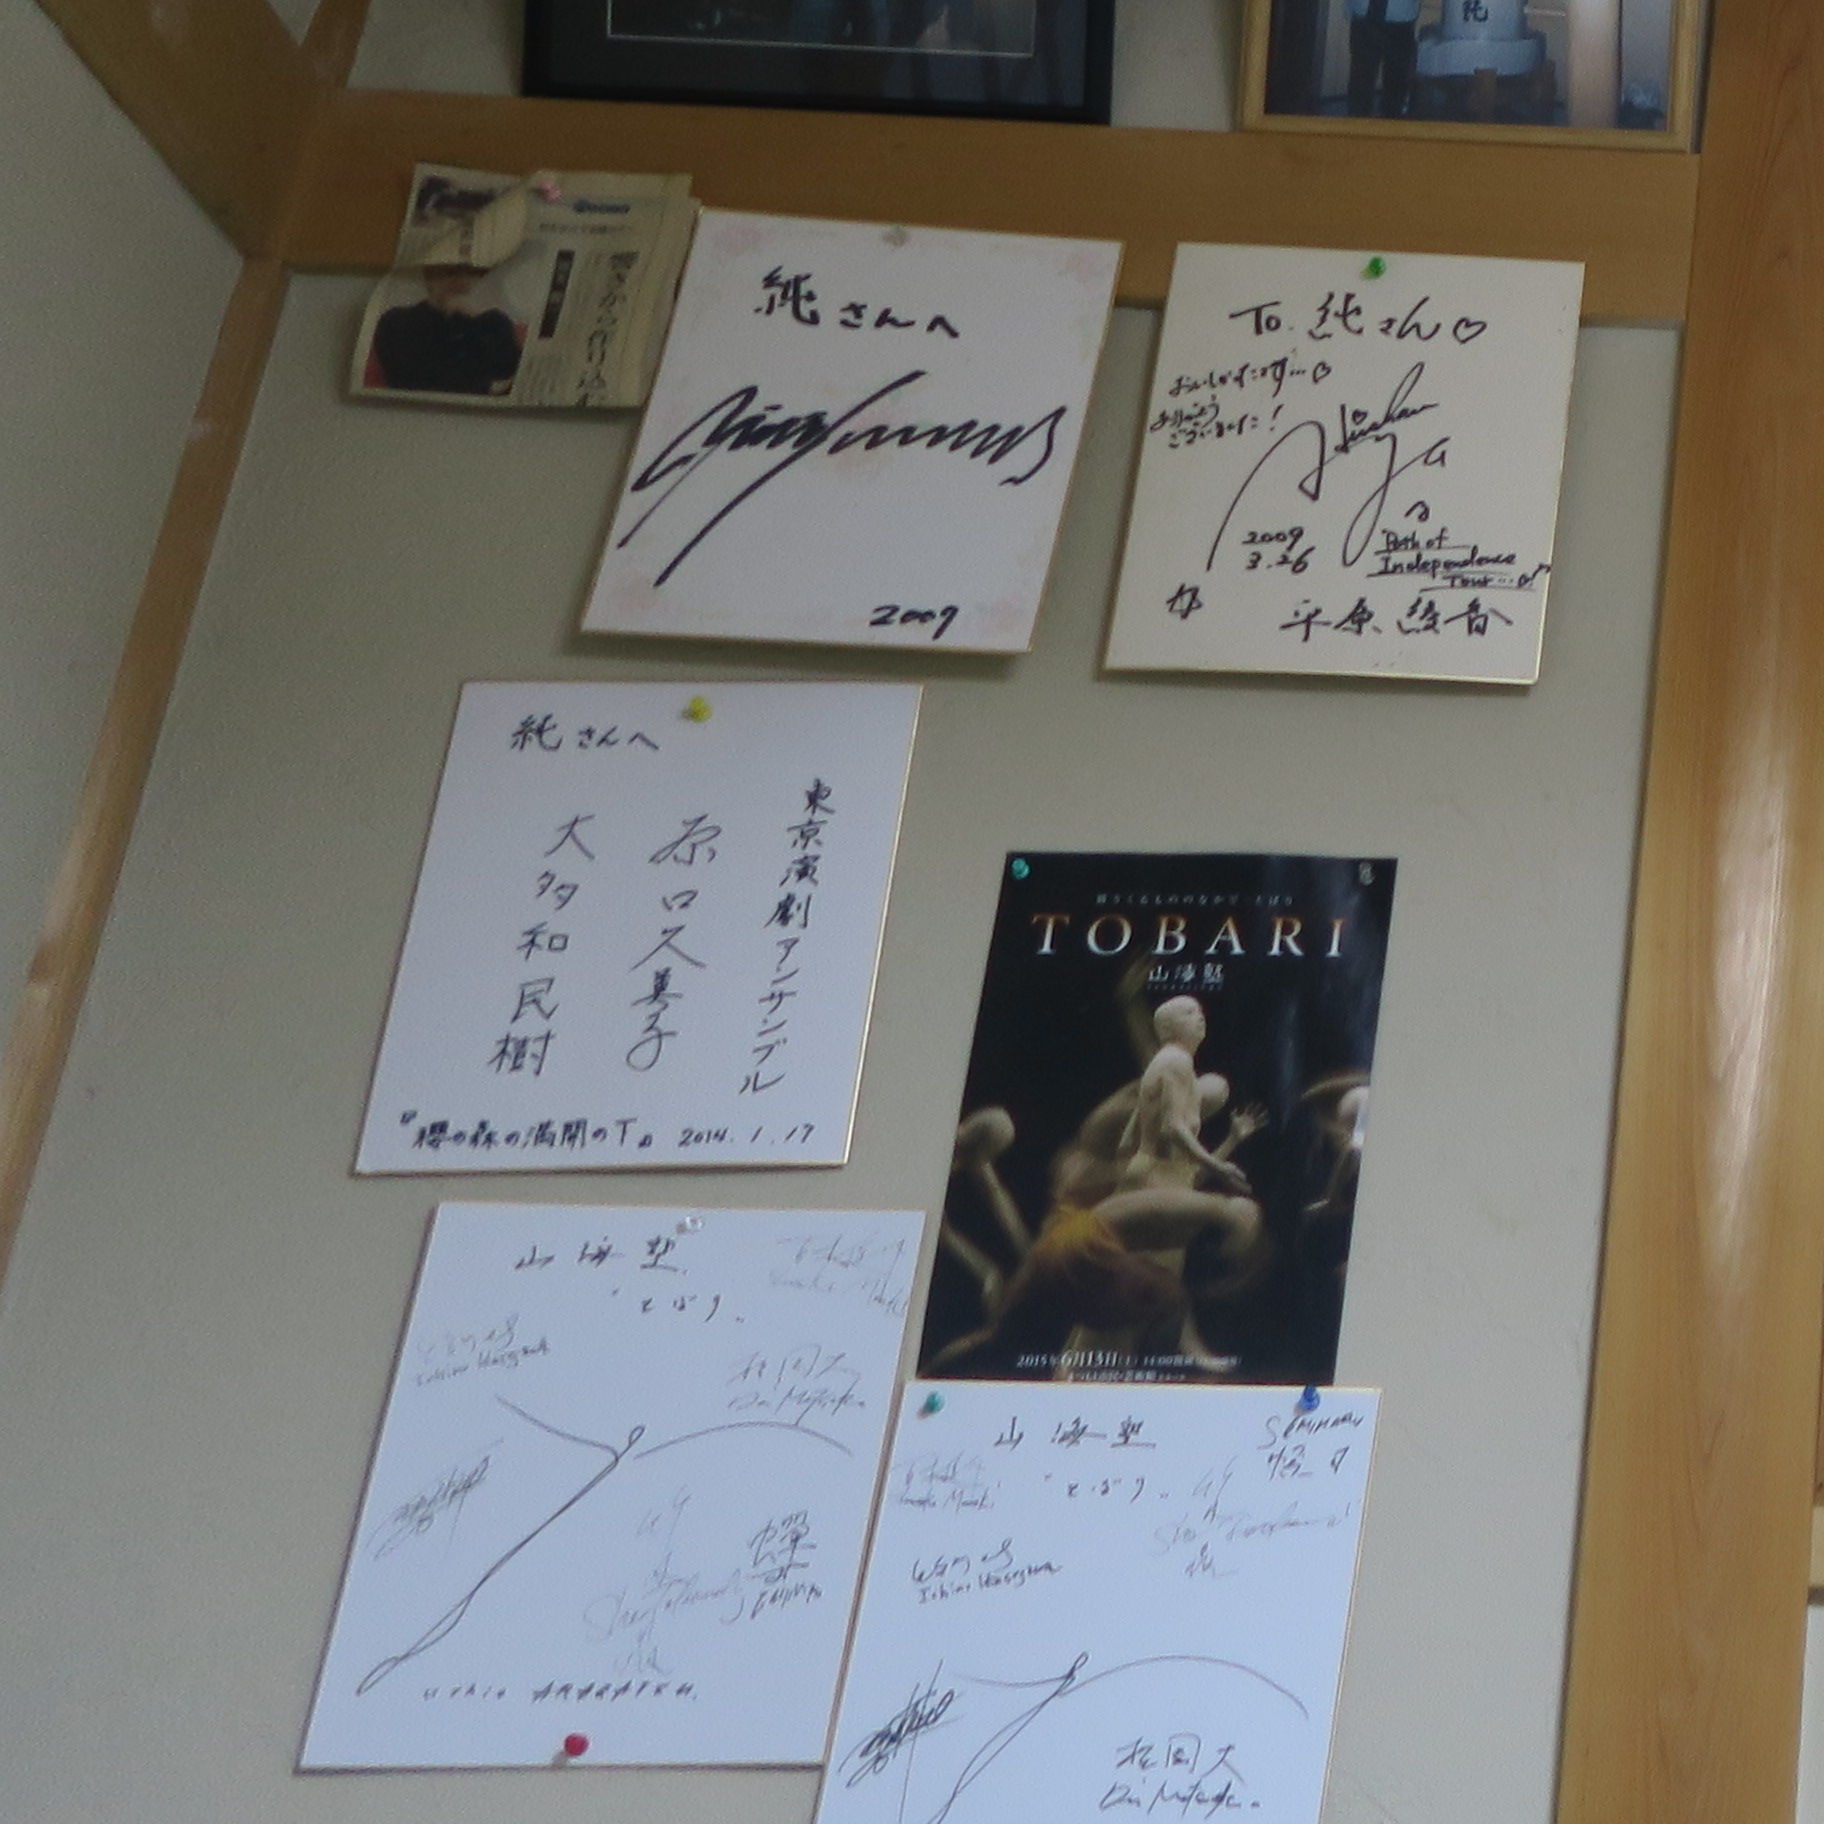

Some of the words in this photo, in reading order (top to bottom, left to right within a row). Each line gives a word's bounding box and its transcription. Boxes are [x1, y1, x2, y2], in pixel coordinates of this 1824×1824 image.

[1241, 525, 1305, 552] 2009
[869, 603, 960, 641] 2009
[510, 714, 660, 753] 純さんへ
[1030, 912, 1346, 958] TOBARI
